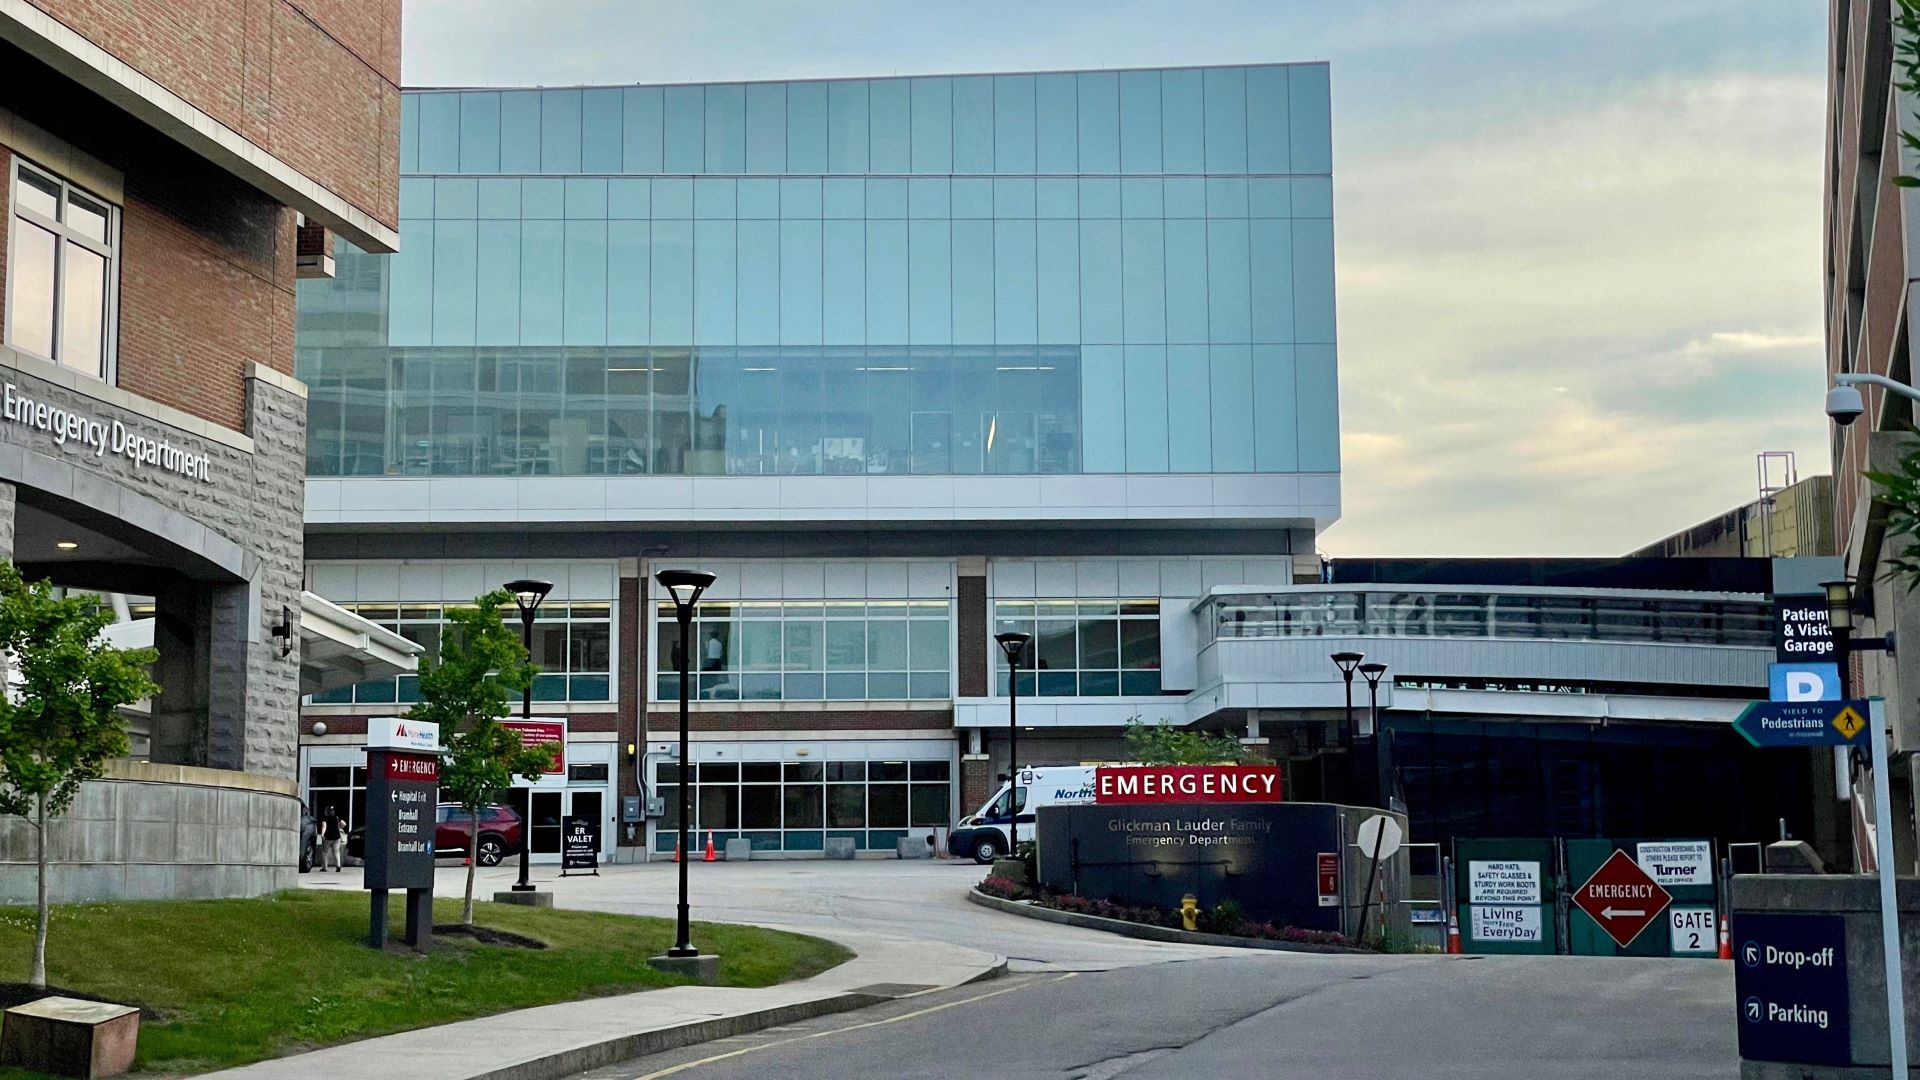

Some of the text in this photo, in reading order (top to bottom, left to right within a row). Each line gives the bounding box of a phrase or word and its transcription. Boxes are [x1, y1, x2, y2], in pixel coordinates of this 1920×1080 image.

[3, 383, 210, 482] Emergency Department
[1784, 624, 1794, 636] &
[1784, 639, 1834, 654] Garage
[1761, 716, 1824, 729] Pedestrians
[400, 759, 436, 775] EMERGENCY
[1101, 774, 1276, 795] EMERGENCY
[399, 790, 417, 804] Hospital
[398, 822, 417, 833] Entrance
[575, 827, 586, 835] ER
[1108, 819, 1272, 833] Glickman Lauder Family
[567, 835, 593, 843] VALET
[1126, 835, 1255, 847] Emergency Department
[1671, 845, 1696, 853] PERSONNEL
[1696, 853, 1703, 861] TO
[1653, 864, 1697, 876] Turner
[1517, 881, 1537, 889] BOOTS
[1589, 884, 1654, 898] EMERGENCY
[1482, 907, 1524, 923] Living
[1673, 912, 1713, 929] GATE
[1483, 926, 1537, 940] EveryDay
[1688, 932, 1701, 949] 2
[1766, 946, 1834, 970] Drop-off
[1768, 1002, 1829, 1028] Parking
